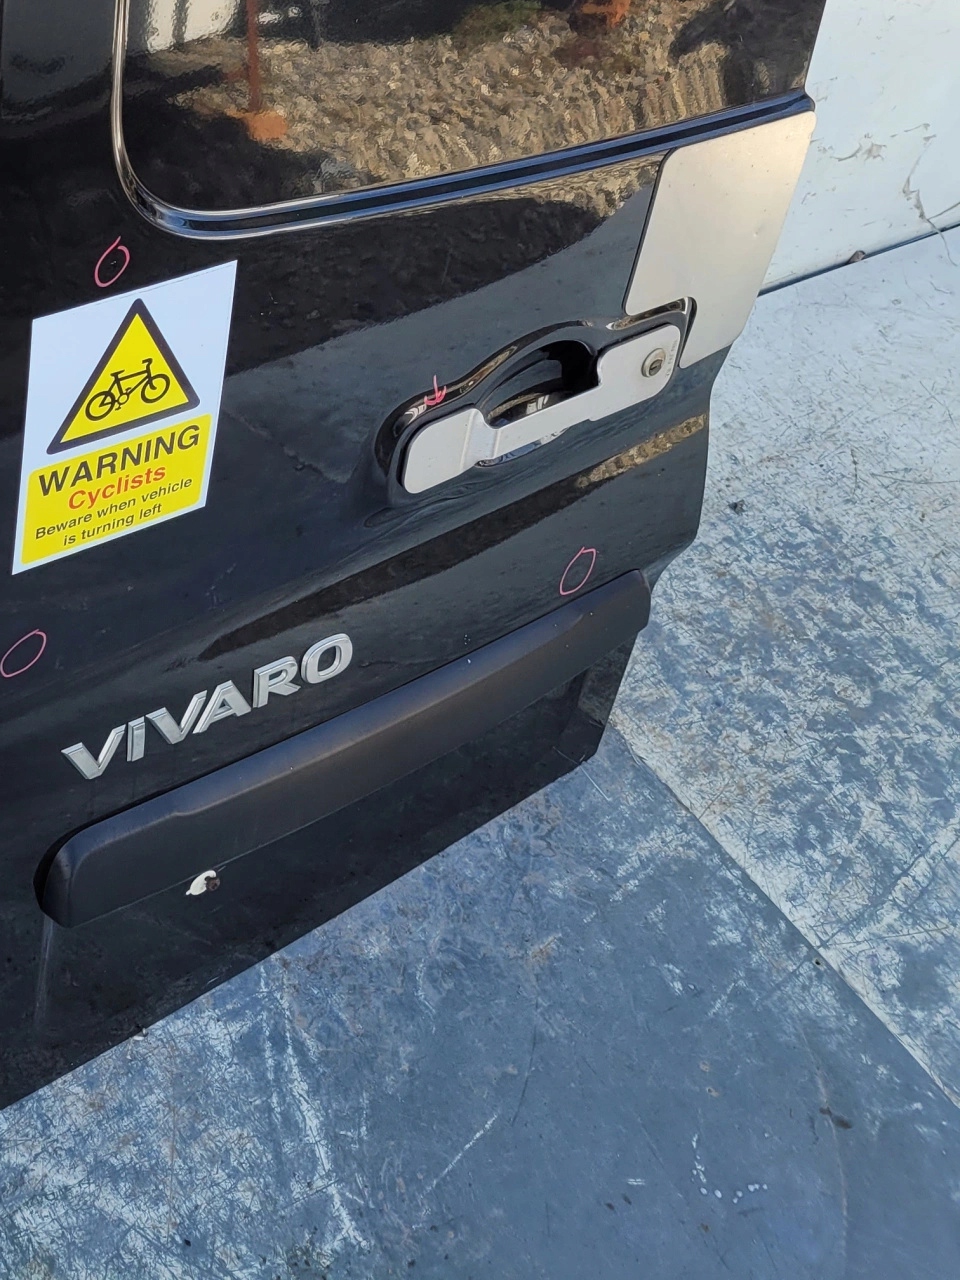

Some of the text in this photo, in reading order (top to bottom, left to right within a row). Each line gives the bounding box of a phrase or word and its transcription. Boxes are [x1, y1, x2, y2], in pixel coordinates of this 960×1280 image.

[38, 424, 201, 497] WARNING
[68, 466, 167, 510] Cyclists
[35, 478, 193, 540] Beware when vehicle
[63, 503, 163, 546] is turning left
[60, 632, 354, 781] VIVARO
